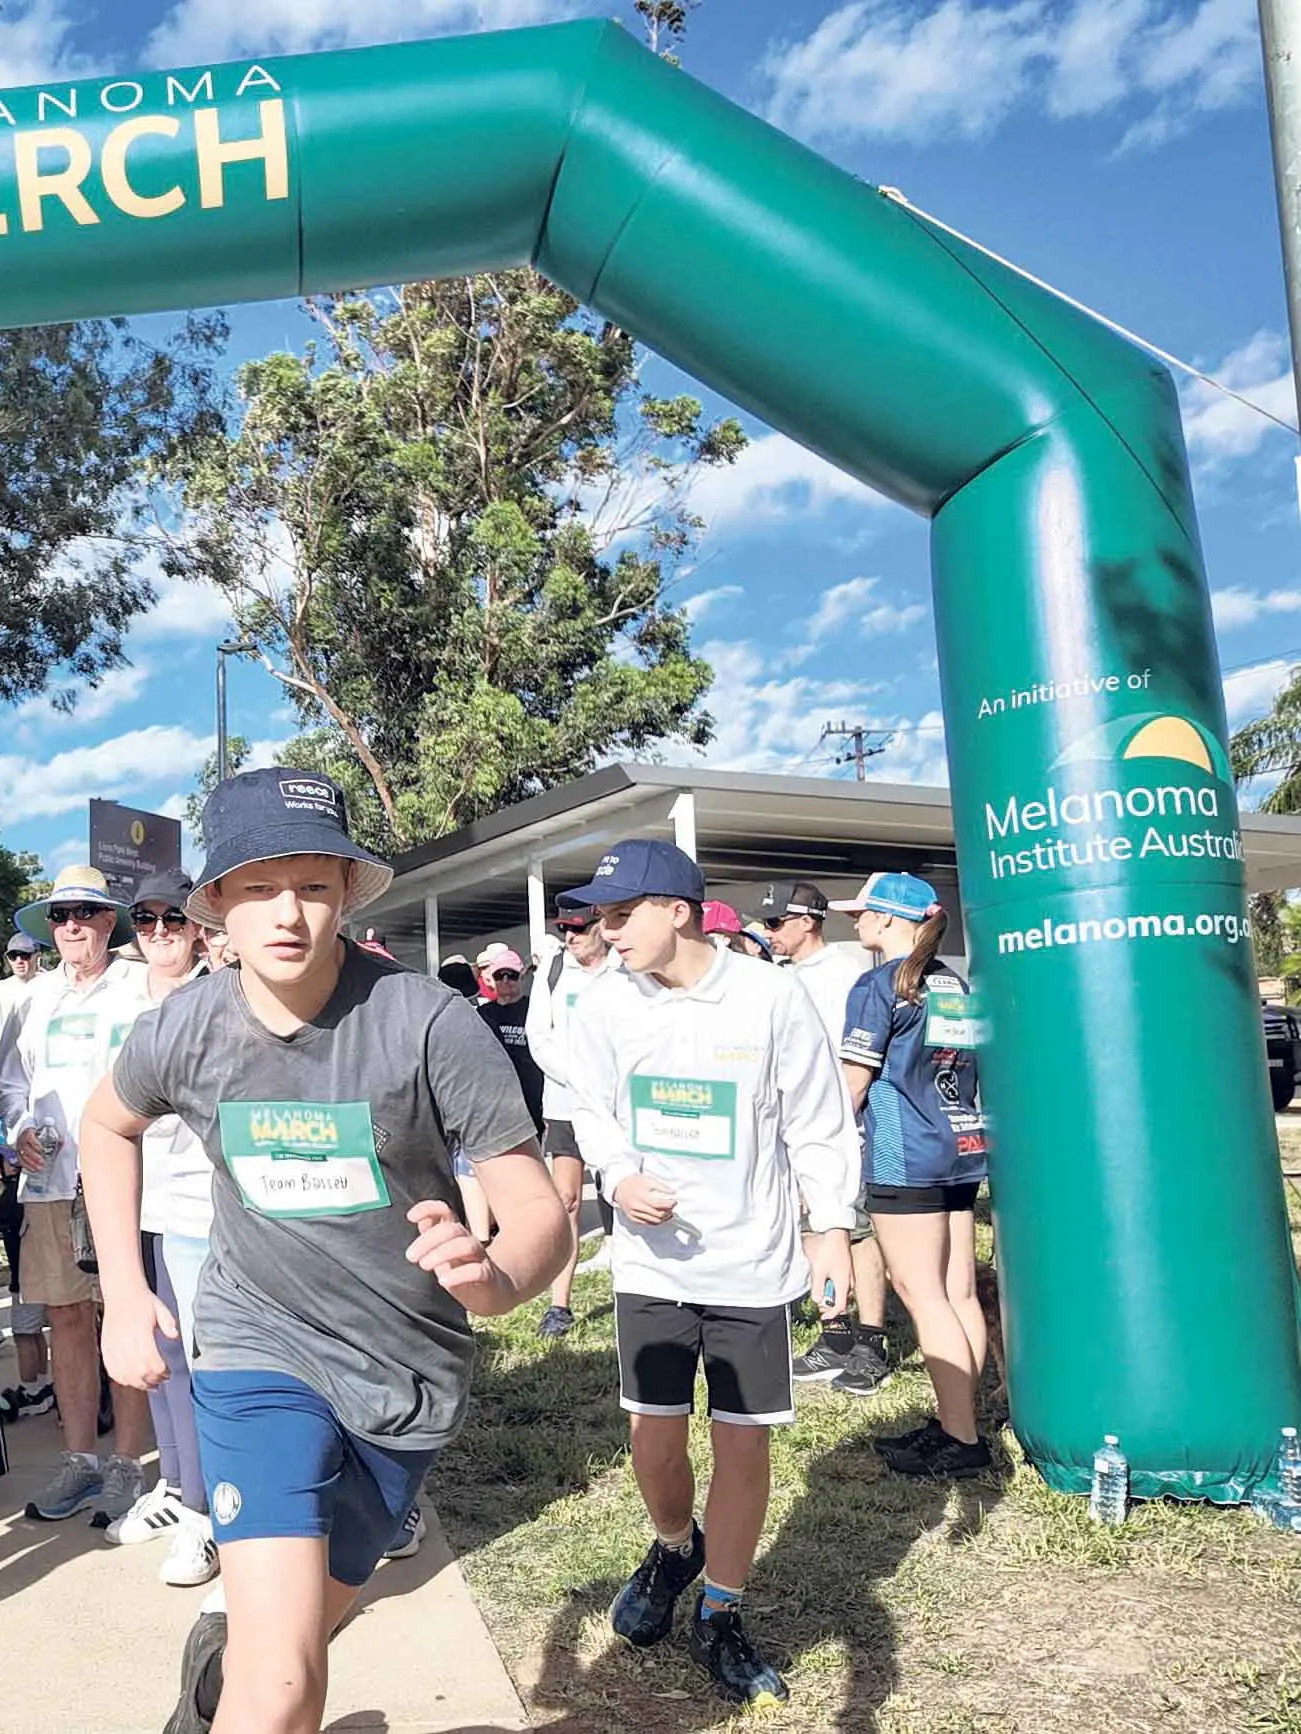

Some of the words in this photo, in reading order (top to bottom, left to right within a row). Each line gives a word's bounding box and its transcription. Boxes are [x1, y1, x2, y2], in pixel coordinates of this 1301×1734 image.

[977, 697, 1005, 720] An
[1011, 673, 1120, 709] initiative
[1127, 668, 1152, 689] of
[284, 800, 313, 809] Works
[288, 784, 330, 798] reece
[985, 785, 1219, 841] Melanoma
[989, 834, 1132, 880] Institute
